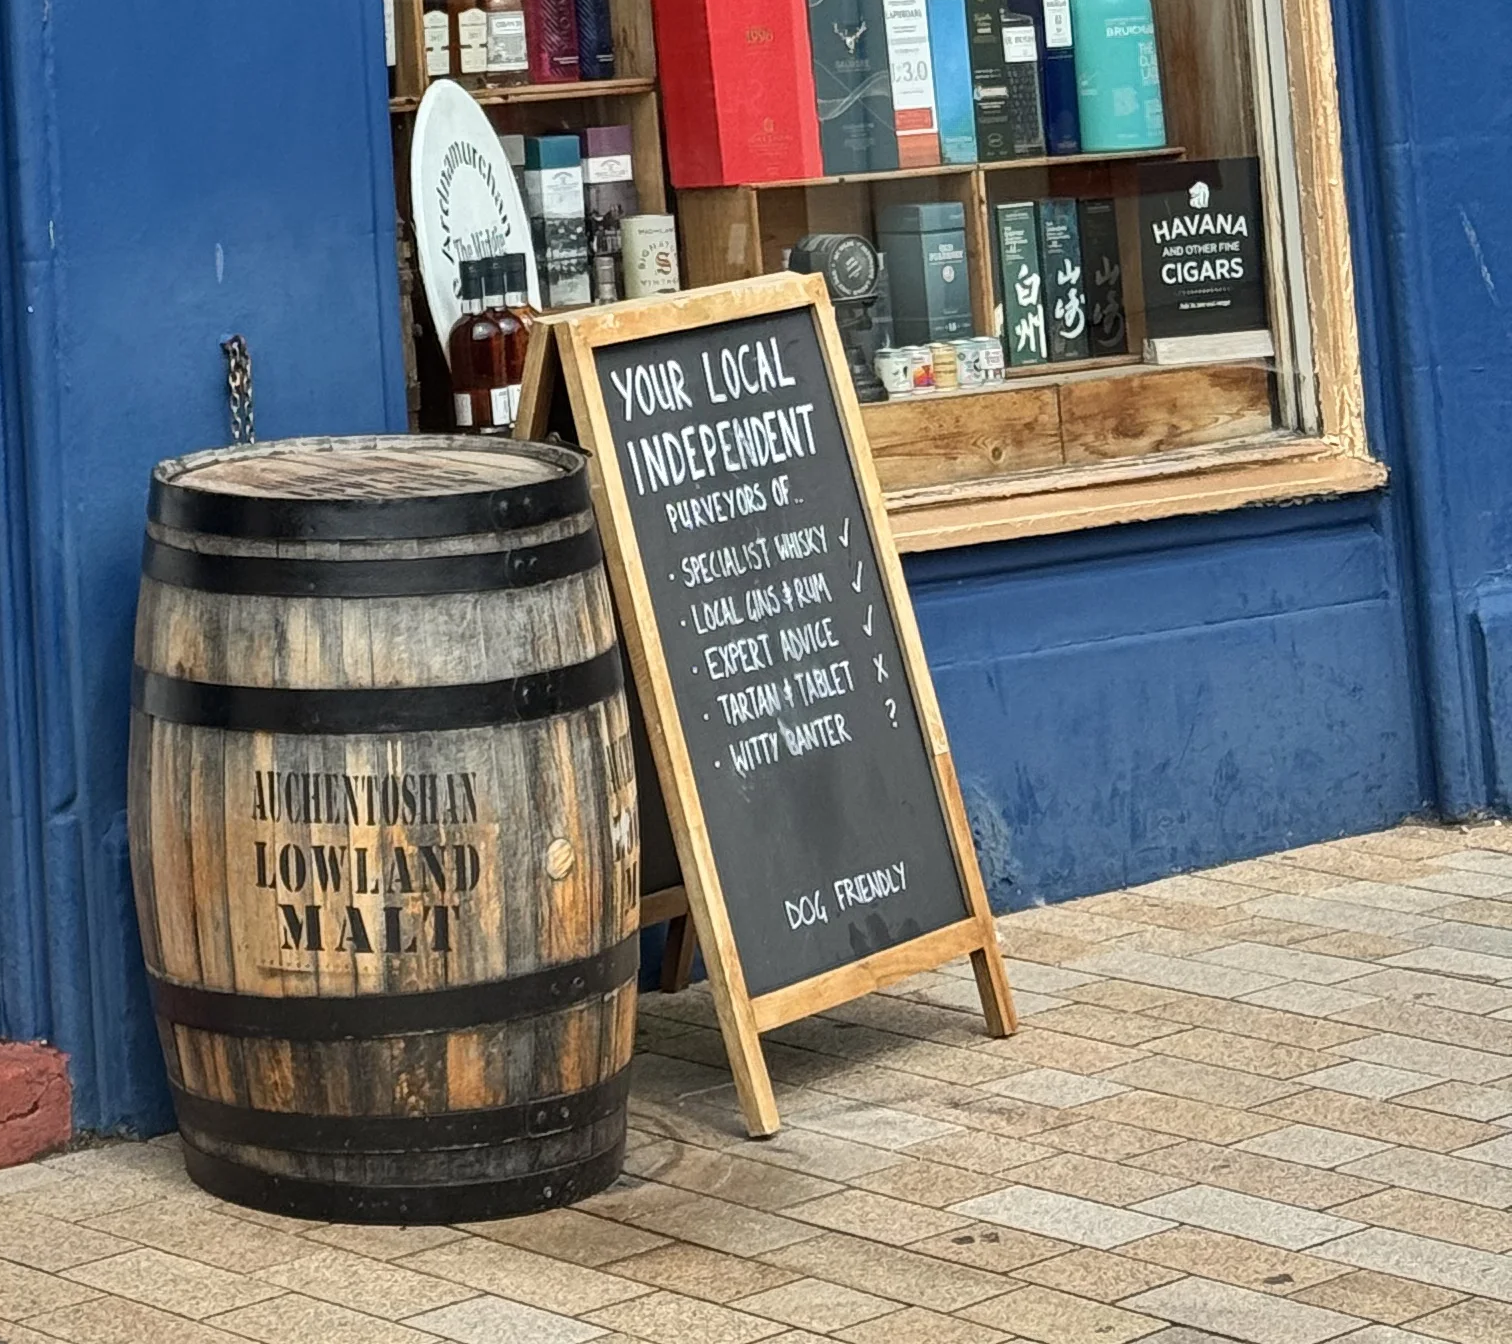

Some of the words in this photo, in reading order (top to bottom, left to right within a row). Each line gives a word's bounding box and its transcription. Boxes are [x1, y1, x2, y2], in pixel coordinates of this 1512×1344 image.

[1152, 213, 1249, 244] HAVANA
[1162, 244, 1184, 257] AND
[1185, 242, 1218, 256] OTHER
[1218, 240, 1241, 252] FINE
[1161, 257, 1245, 285] CIGARS
[610, 359, 693, 422] YOUR
[701, 336, 796, 404] LOCAL
[627, 403, 816, 496] INDEPENDENT
[665, 482, 768, 534] PURVEYORS
[681, 537, 771, 588] SPECIALIST
[774, 524, 828, 561] WHISKY
[691, 596, 745, 635] LOCAL
[745, 584, 781, 622] GINS
[794, 572, 833, 609] RUM
[704, 633, 774, 681] EXPERT
[780, 617, 840, 662] ADVICE
[717, 682, 782, 727] TARTAN
[794, 660, 855, 707] TABLET
[729, 731, 779, 779] WITTY
[786, 713, 853, 757] BANTER
[251, 770, 478, 827] AUCHENTOSHAN
[253, 840, 481, 895] LOWLAND
[785, 889, 829, 930] DOG
[833, 860, 907, 912] FRIENDLY
[277, 902, 461, 954] MALT
